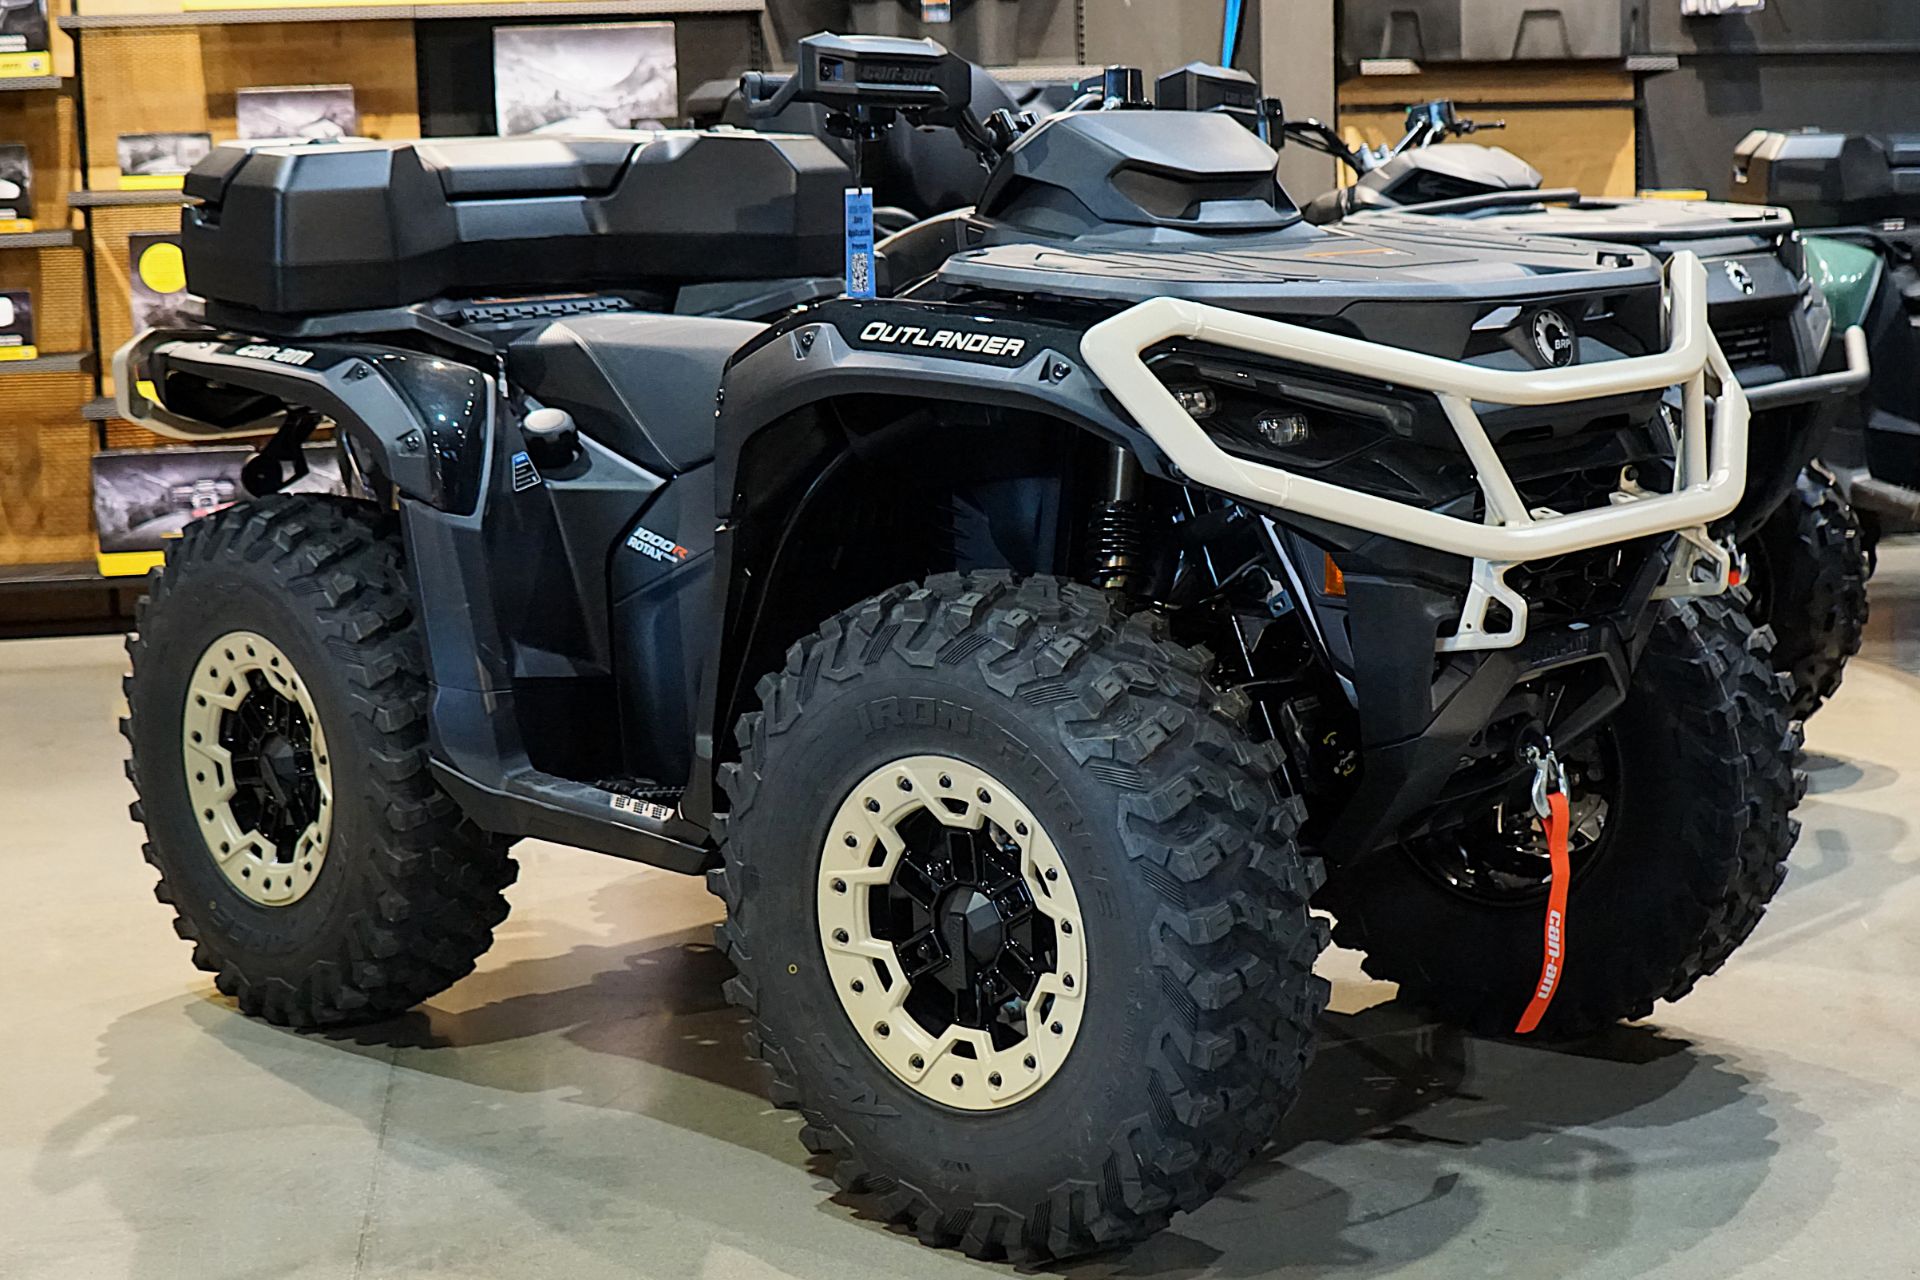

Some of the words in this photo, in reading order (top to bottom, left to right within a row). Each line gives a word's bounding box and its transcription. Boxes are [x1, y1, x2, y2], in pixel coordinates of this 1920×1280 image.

[860, 321, 1025, 357] OUTLANDER
[1555, 338, 1571, 350] BRP
[627, 535, 664, 561] ROTAX
[633, 526, 689, 560] 1000R
[1538, 909, 1561, 999] can-am
